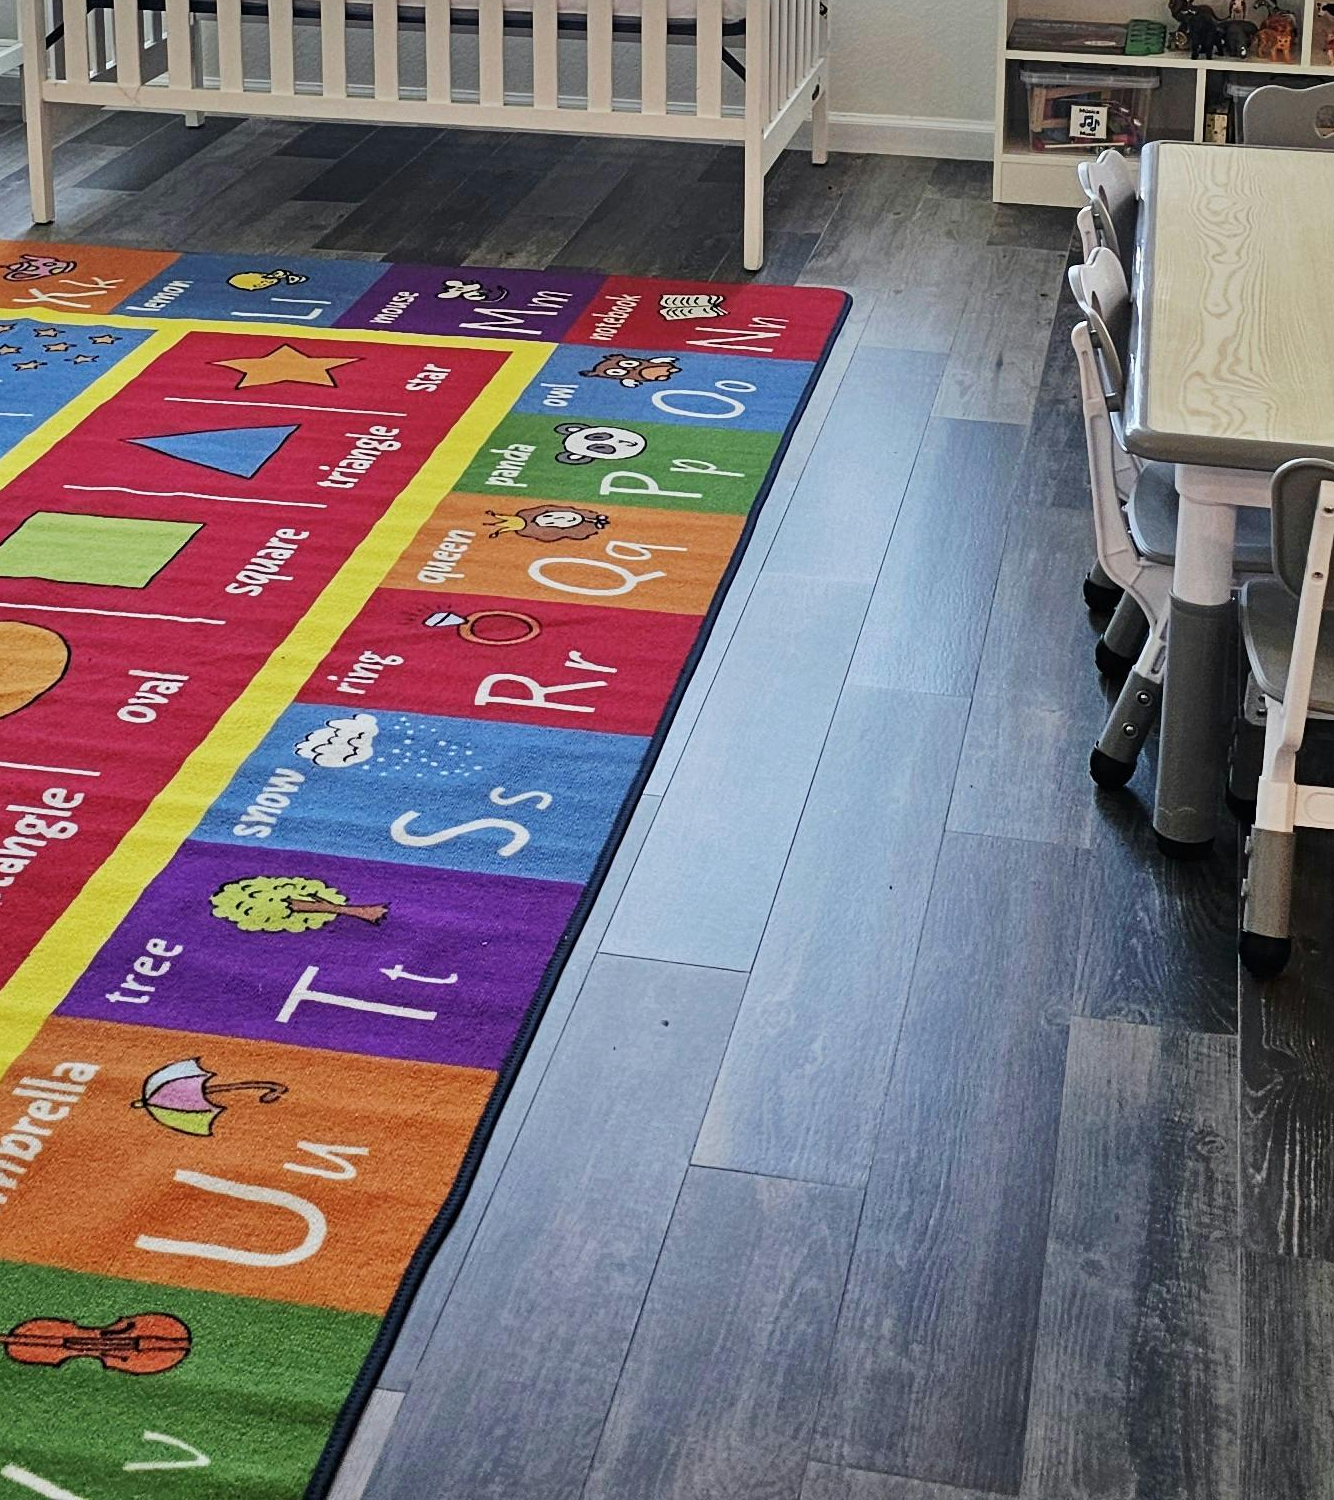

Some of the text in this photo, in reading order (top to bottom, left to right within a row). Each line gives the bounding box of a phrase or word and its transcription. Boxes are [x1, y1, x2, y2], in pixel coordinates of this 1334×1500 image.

[144, 279, 194, 313] lemon
[370, 289, 420, 327] mouse
[591, 294, 641, 341] notebook
[408, 363, 451, 394] star
[543, 382, 580, 408] owl
[317, 425, 399, 489] triangle
[484, 441, 537, 489] panda
[224, 526, 309, 597] square
[417, 528, 475, 585] queen
[337, 649, 403, 694] ring
[117, 669, 189, 725] oval
[234, 767, 306, 838] snow
[106, 938, 184, 1006] tree
